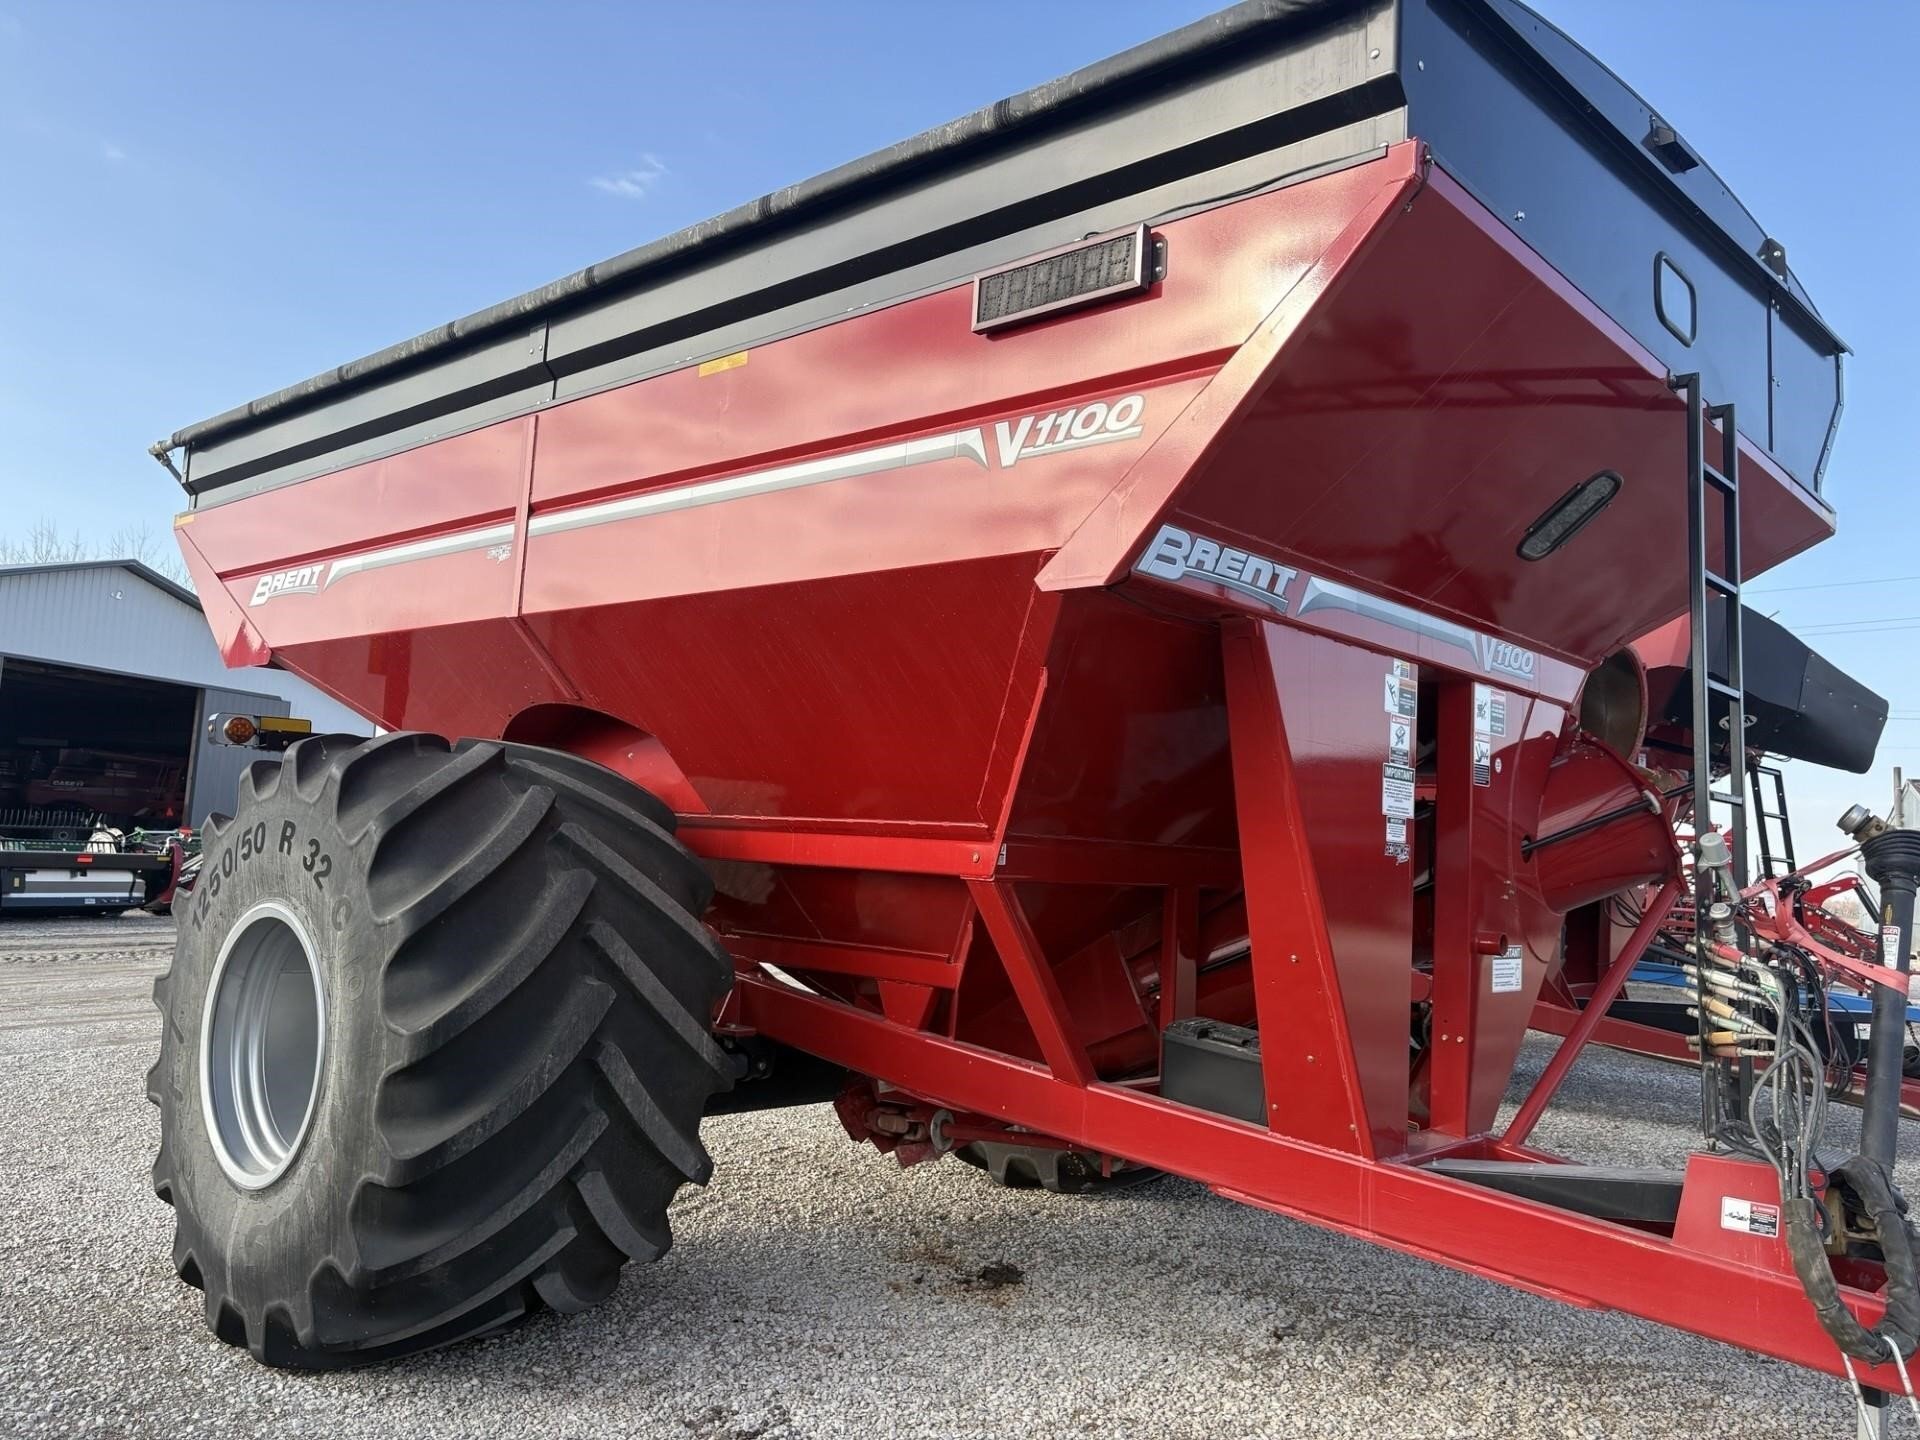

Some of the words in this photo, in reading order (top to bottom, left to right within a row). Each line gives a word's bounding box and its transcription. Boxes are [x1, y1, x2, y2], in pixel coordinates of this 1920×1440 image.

[994, 395, 1145, 468] V1100
[1136, 523, 1298, 600] BRENT
[248, 564, 325, 608] BRENT
[1481, 634, 1534, 673] V1100
[1384, 765, 1414, 782] IMPORTANT
[302, 838, 333, 891] 32
